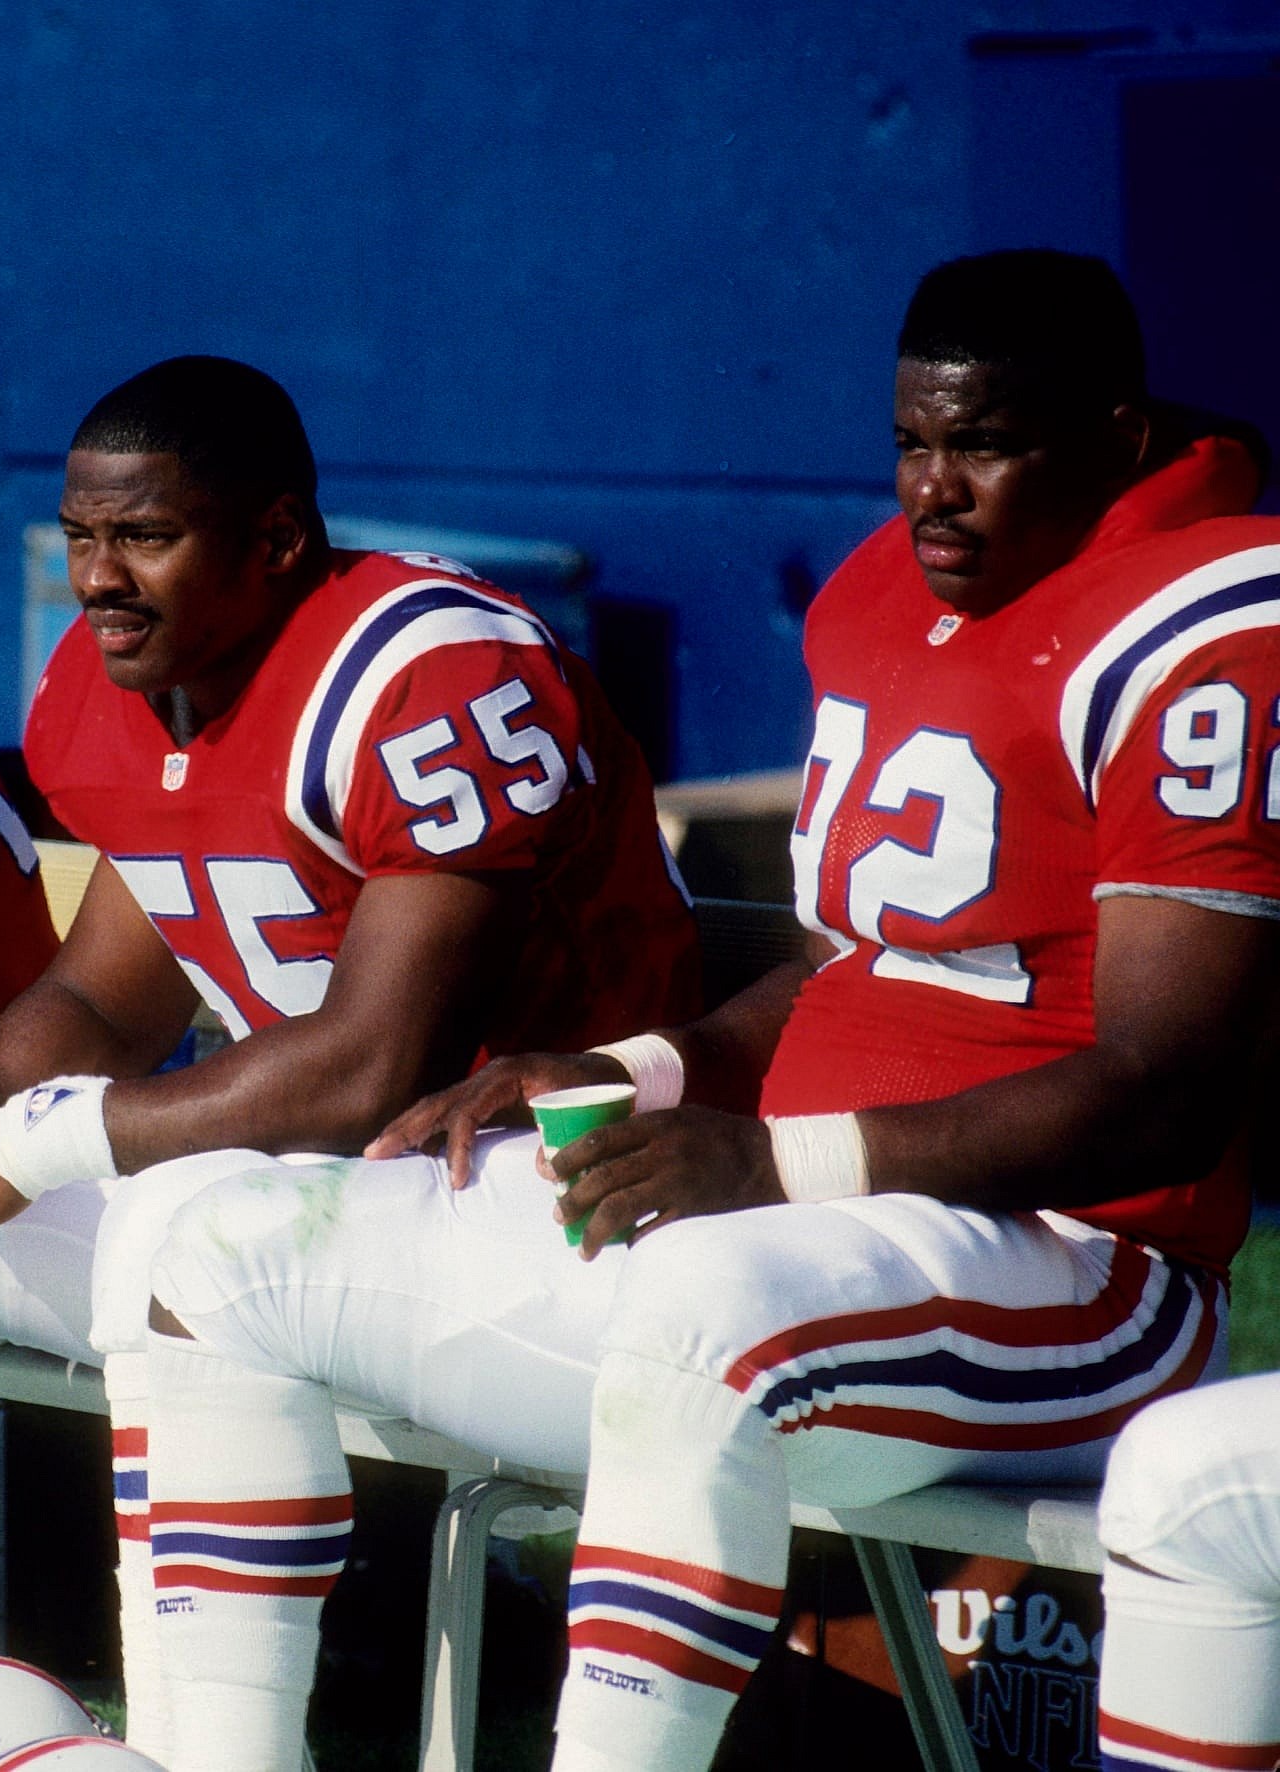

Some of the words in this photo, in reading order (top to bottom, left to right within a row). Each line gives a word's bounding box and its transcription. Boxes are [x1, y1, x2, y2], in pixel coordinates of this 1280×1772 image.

[373, 675, 570, 856] 55
[1154, 678, 1280, 823] 9
[789, 690, 1036, 1007] 92
